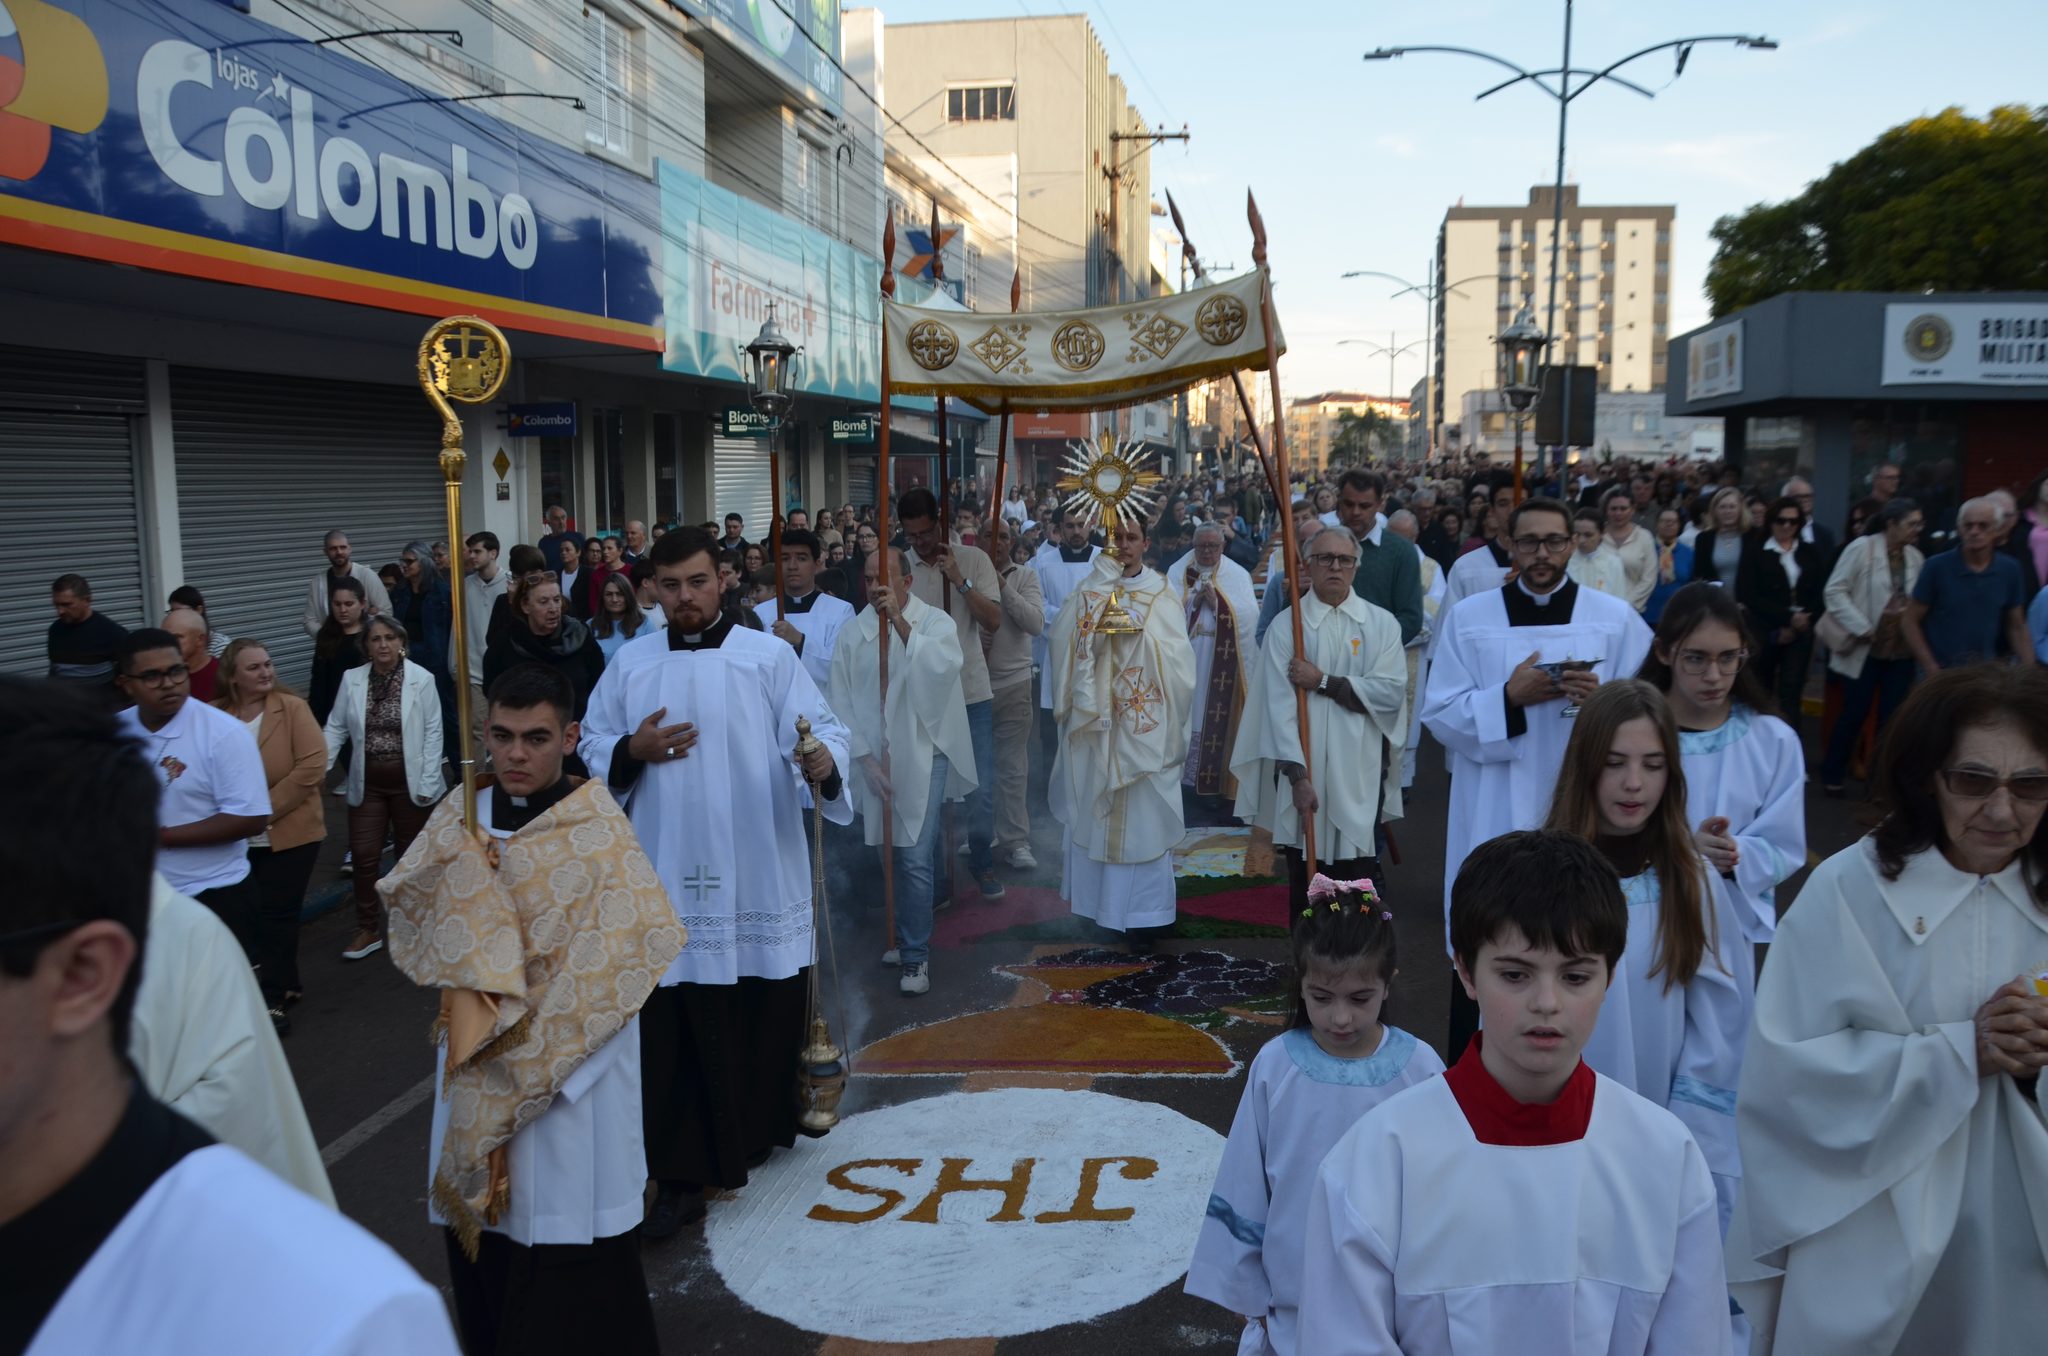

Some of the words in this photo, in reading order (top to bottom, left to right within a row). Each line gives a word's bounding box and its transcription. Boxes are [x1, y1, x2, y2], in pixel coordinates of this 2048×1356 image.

[216, 47, 259, 91] lojas
[136, 39, 538, 270] Colombo
[523, 414, 572, 426] Colombo
